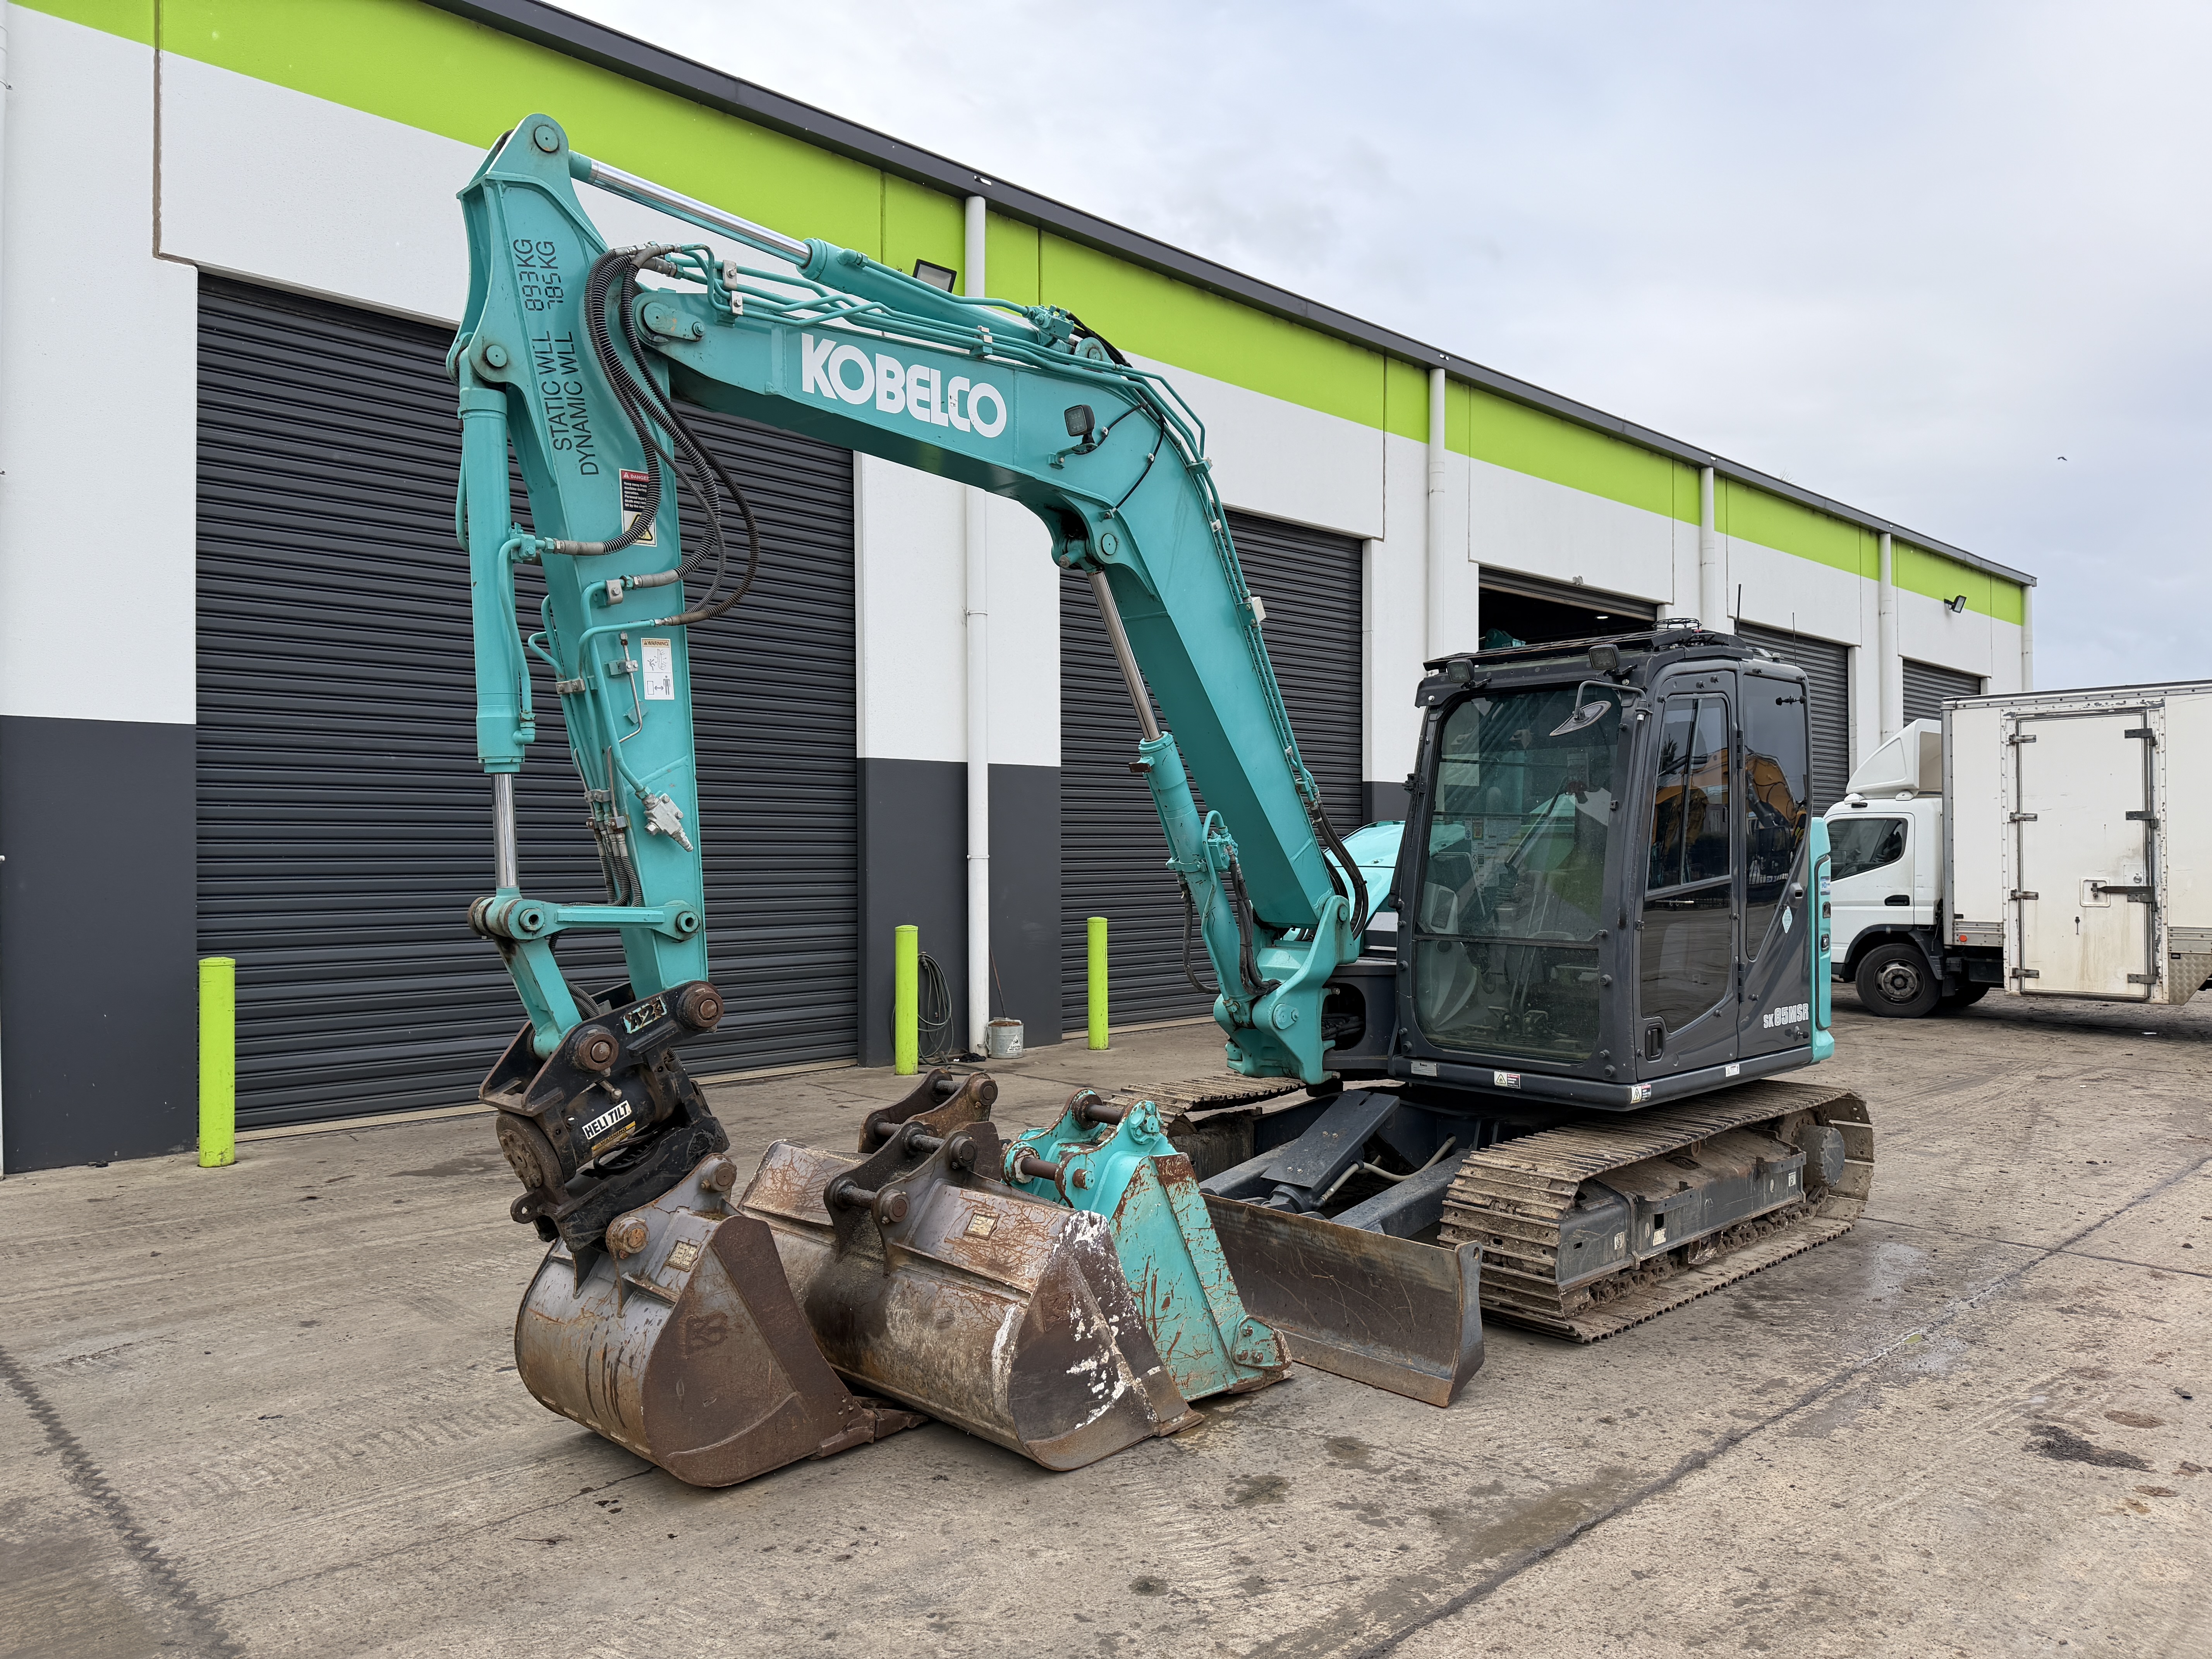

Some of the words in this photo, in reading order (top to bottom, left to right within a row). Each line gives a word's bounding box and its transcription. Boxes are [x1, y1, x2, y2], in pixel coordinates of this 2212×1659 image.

[532, 330, 556, 375] WLL
[555, 331, 579, 375] WLL
[801, 332, 1007, 438] KOBELCO
[541, 381, 572, 450] STATIC
[563, 381, 599, 475] DYNAMIC
[584, 1116, 609, 1138] HELI
[608, 1103, 627, 1123] TILT
